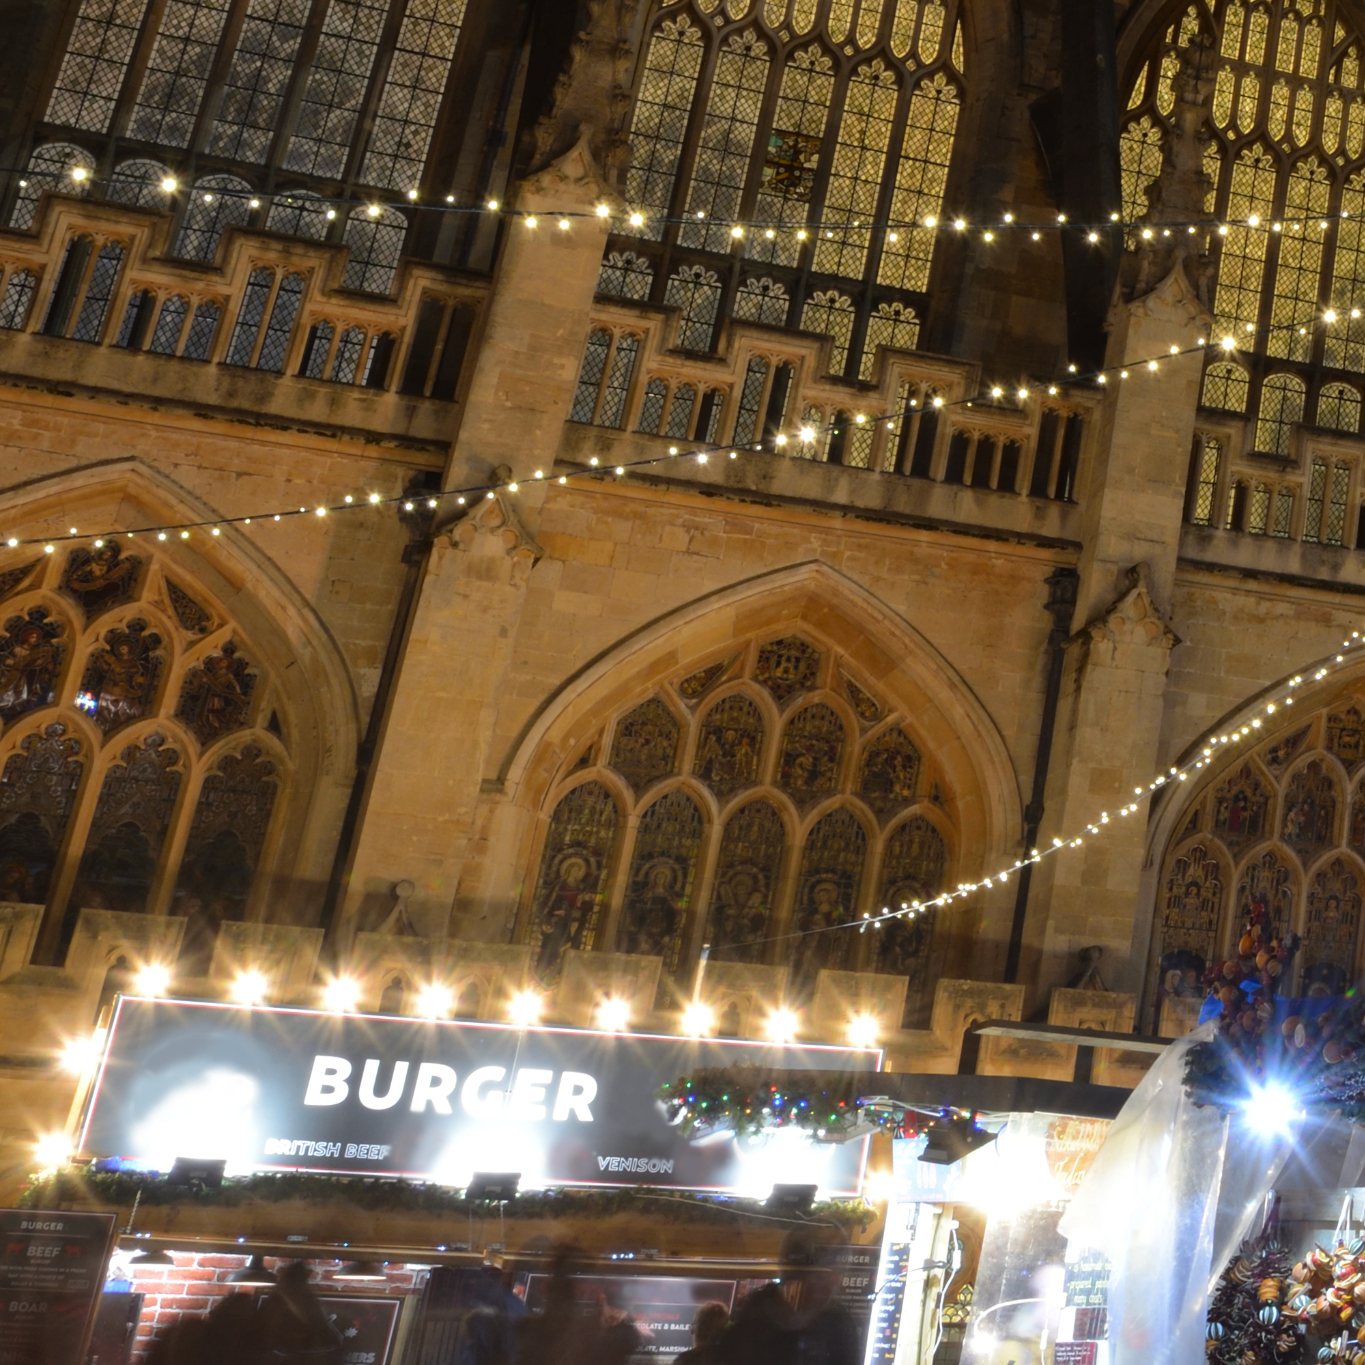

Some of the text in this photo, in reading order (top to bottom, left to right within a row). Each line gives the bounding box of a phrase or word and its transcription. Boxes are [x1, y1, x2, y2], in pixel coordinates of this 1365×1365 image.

[303, 1054, 599, 1123] BURGER
[263, 1137, 390, 1160] BRITISH BEEF
[597, 1156, 674, 1175] VENISON
[20, 1221, 64, 1231] BURGER
[26, 1246, 62, 1258] BEEF
[835, 1255, 870, 1264] BURGER
[842, 1277, 870, 1287] BEEF
[9, 1301, 48, 1313] BOAR
[635, 1322, 663, 1330] COLATE
